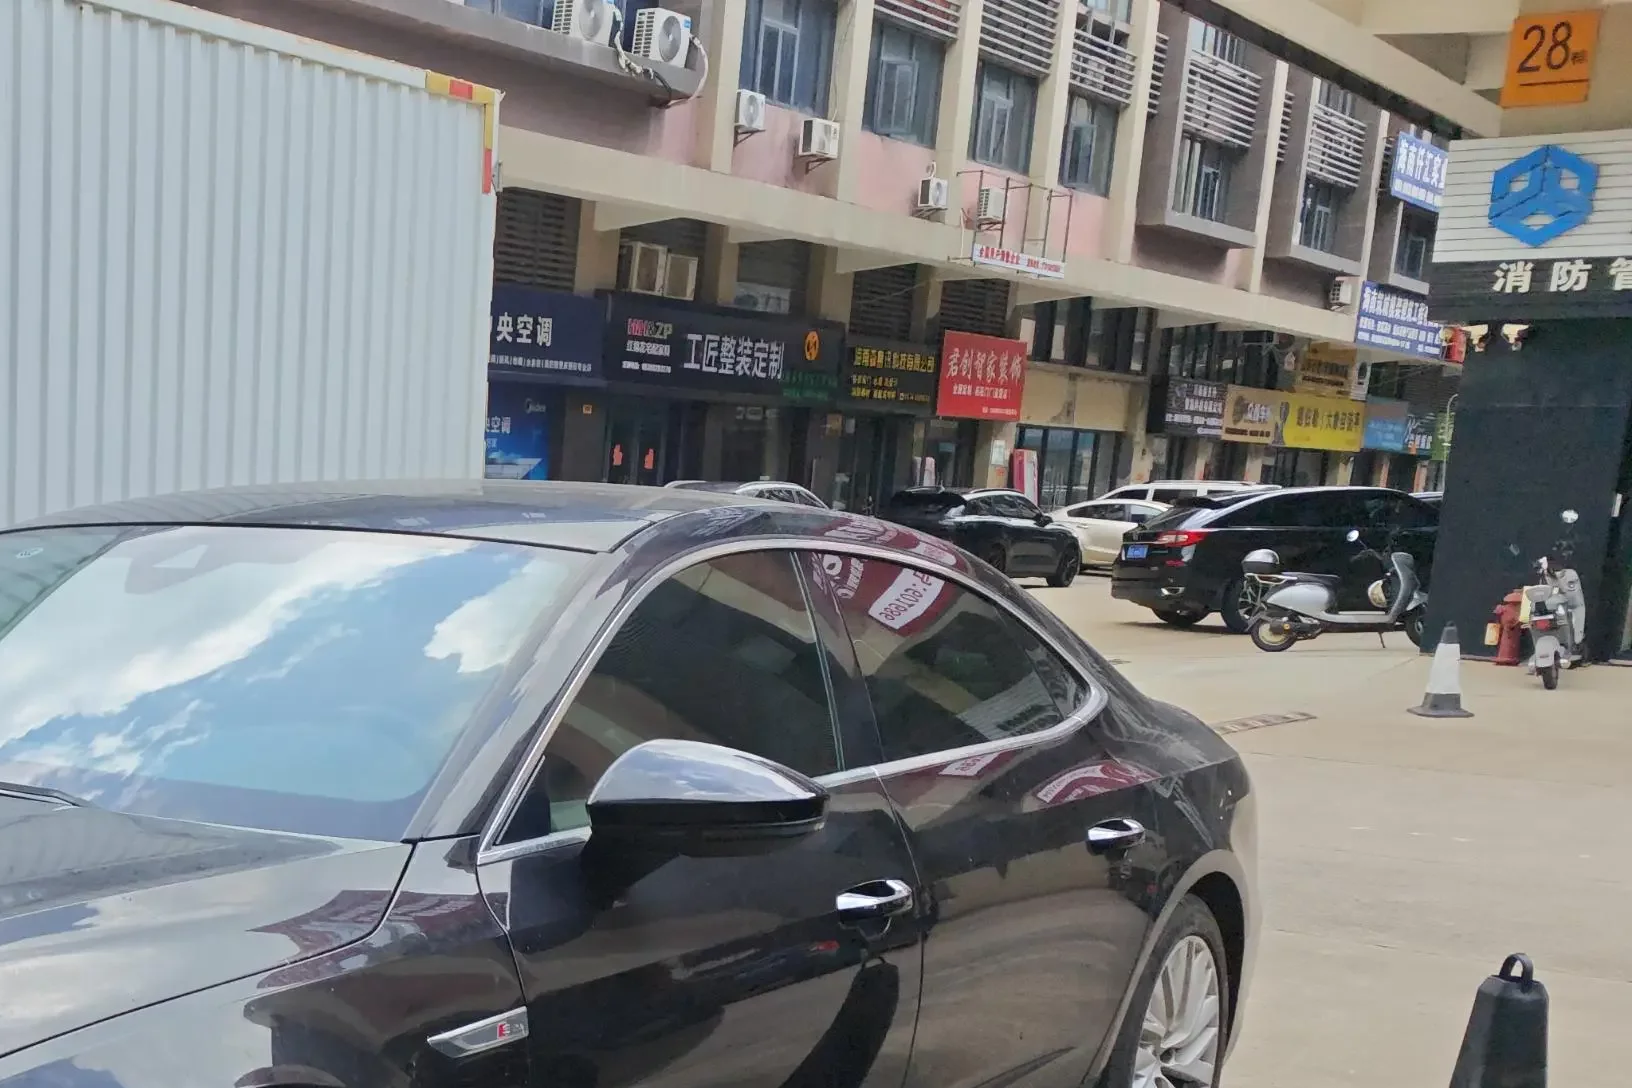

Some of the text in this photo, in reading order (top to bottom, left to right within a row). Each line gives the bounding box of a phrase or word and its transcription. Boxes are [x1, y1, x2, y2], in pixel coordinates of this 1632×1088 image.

[488, 312, 553, 347] 央空调
[683, 333, 785, 380] 工匠整装定制
